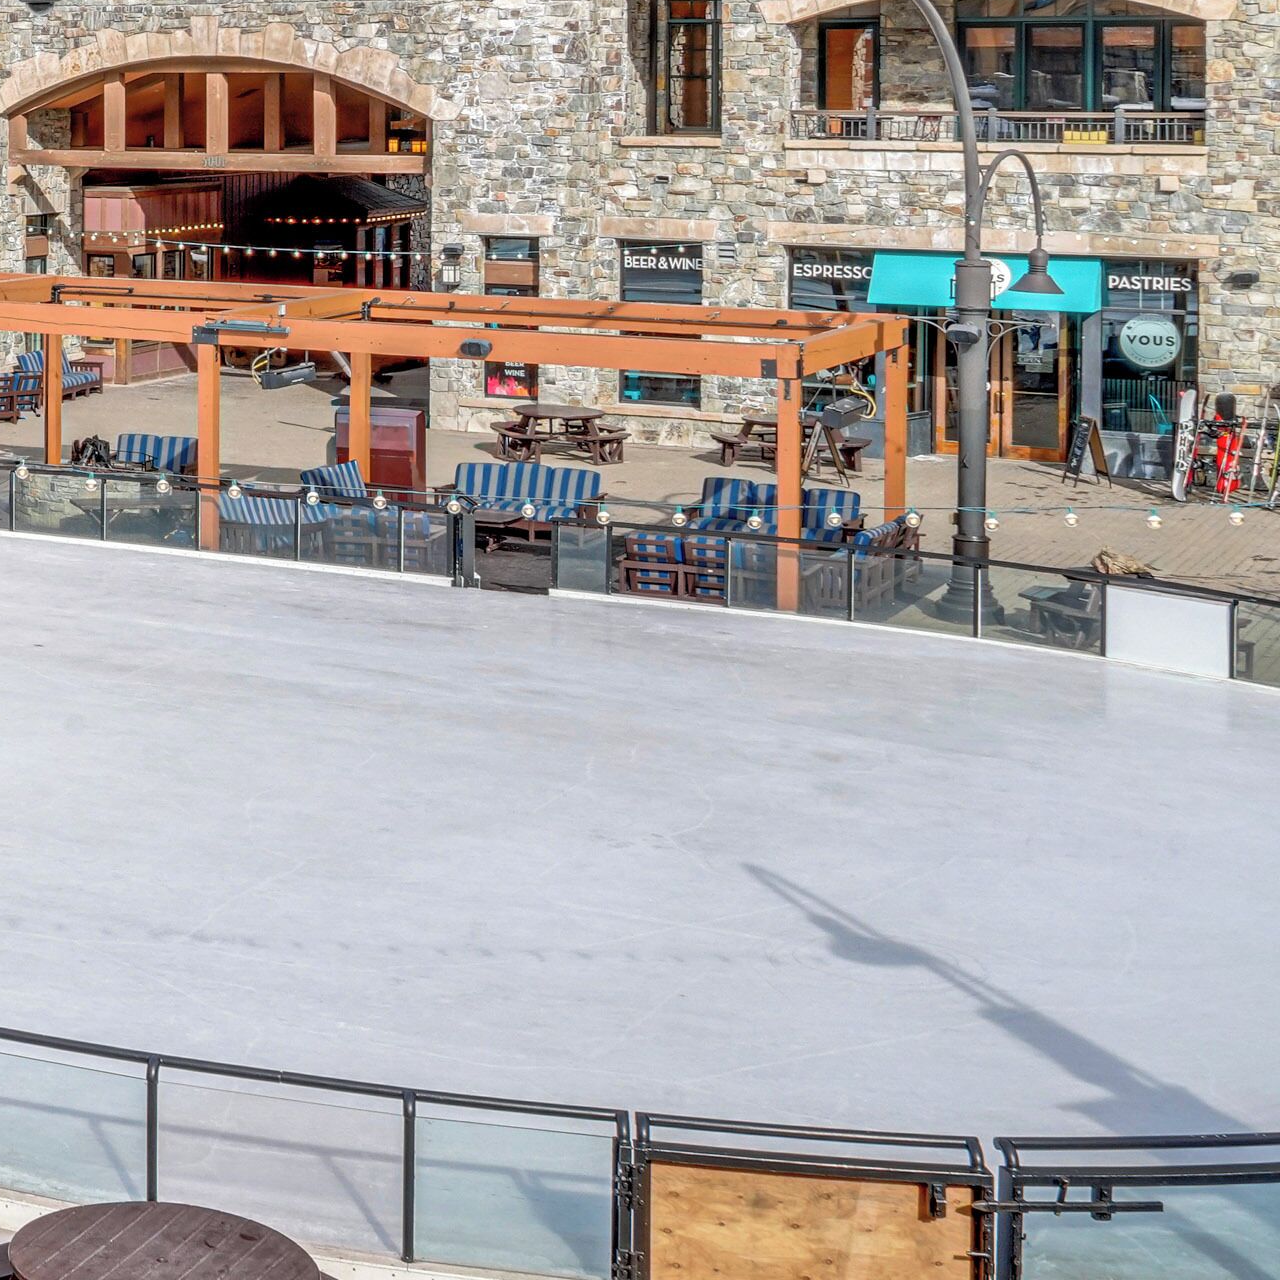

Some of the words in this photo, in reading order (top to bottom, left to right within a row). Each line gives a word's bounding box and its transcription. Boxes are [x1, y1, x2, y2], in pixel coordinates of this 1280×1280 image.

[623, 255, 657, 269] BEER
[668, 257, 704, 271] WINE
[1108, 275, 1192, 292] PASTRIES
[1126, 334, 1175, 347] VOUS
[504, 369, 526, 377] WINE
